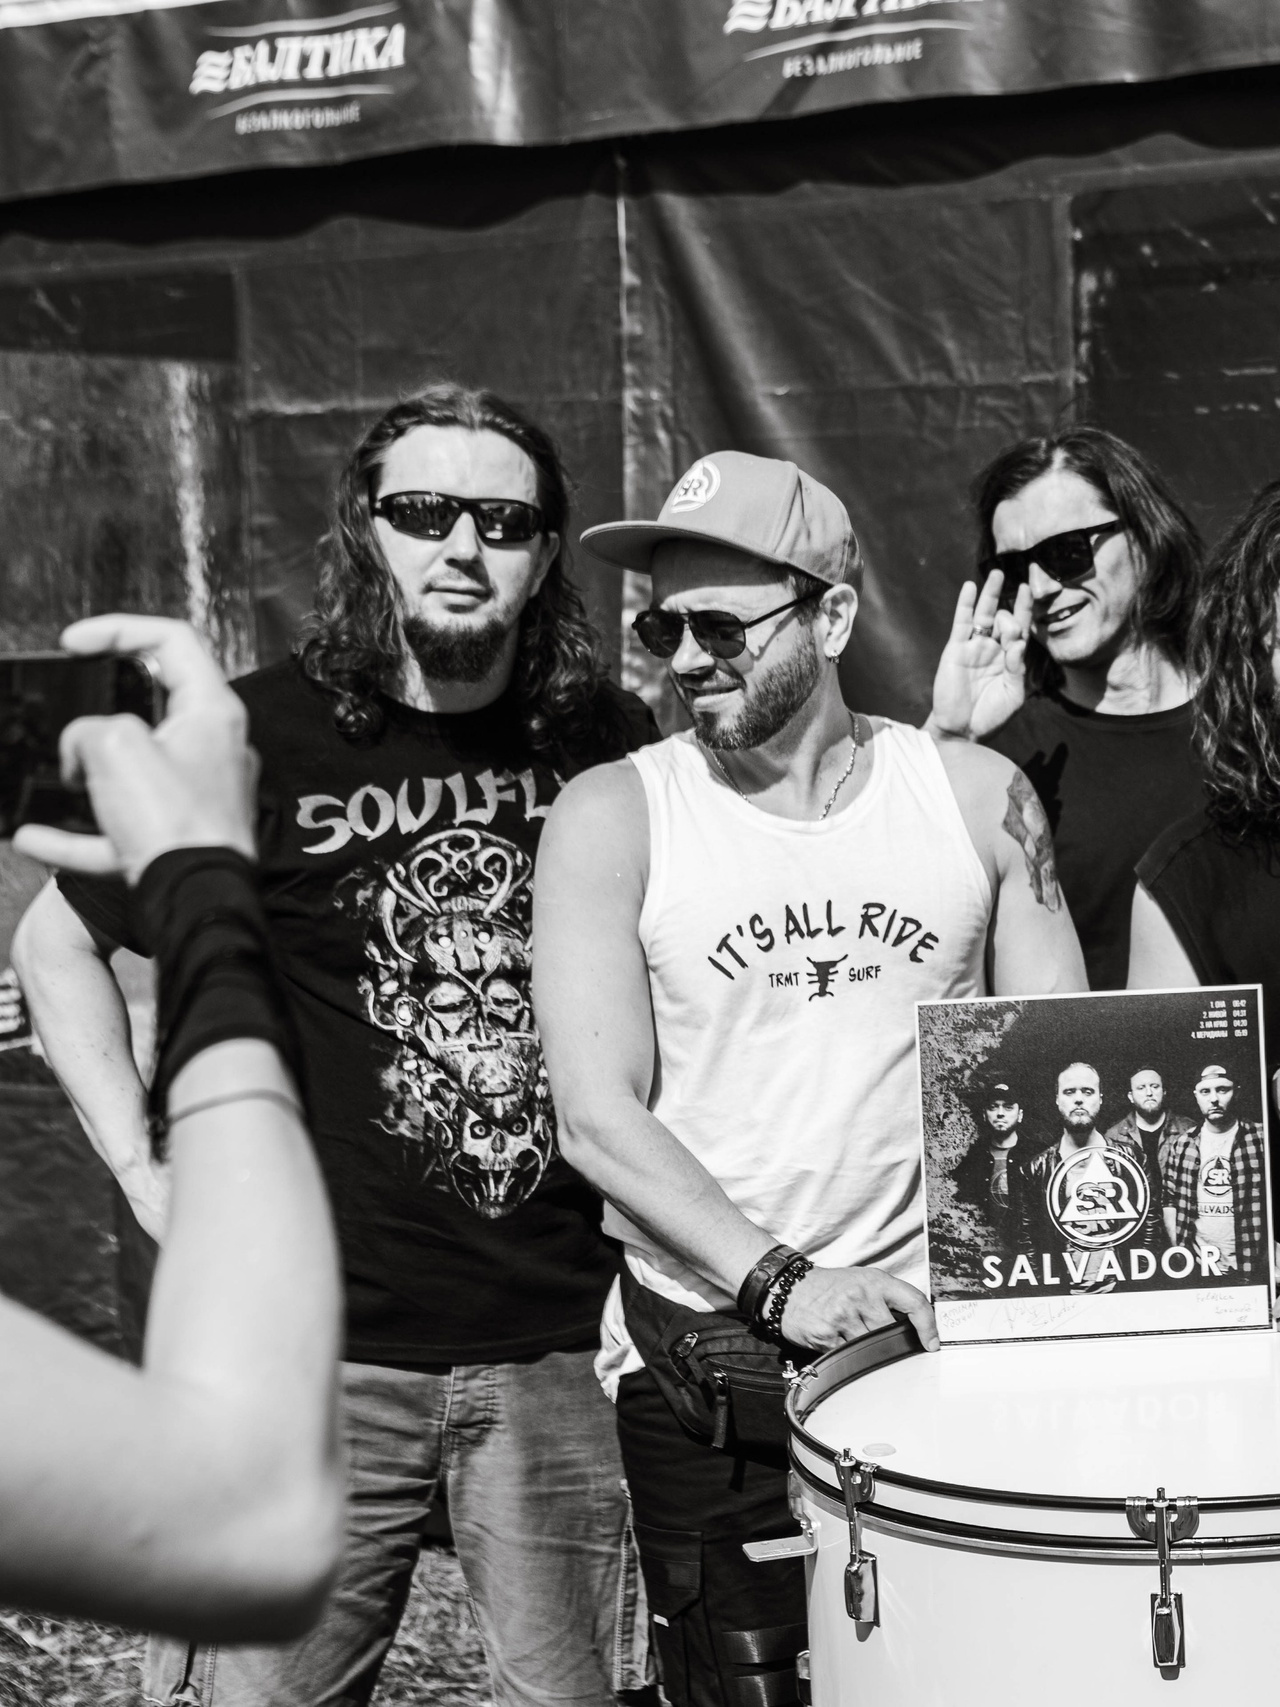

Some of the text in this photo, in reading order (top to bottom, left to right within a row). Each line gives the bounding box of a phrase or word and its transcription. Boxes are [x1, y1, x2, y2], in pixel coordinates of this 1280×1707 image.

[296, 767, 566, 855] SOULFL
[707, 899, 940, 980] IT'S ALL RIDE
[768, 965, 882, 988] TRMT SURF
[981, 1244, 1223, 1290] SALVADOR
